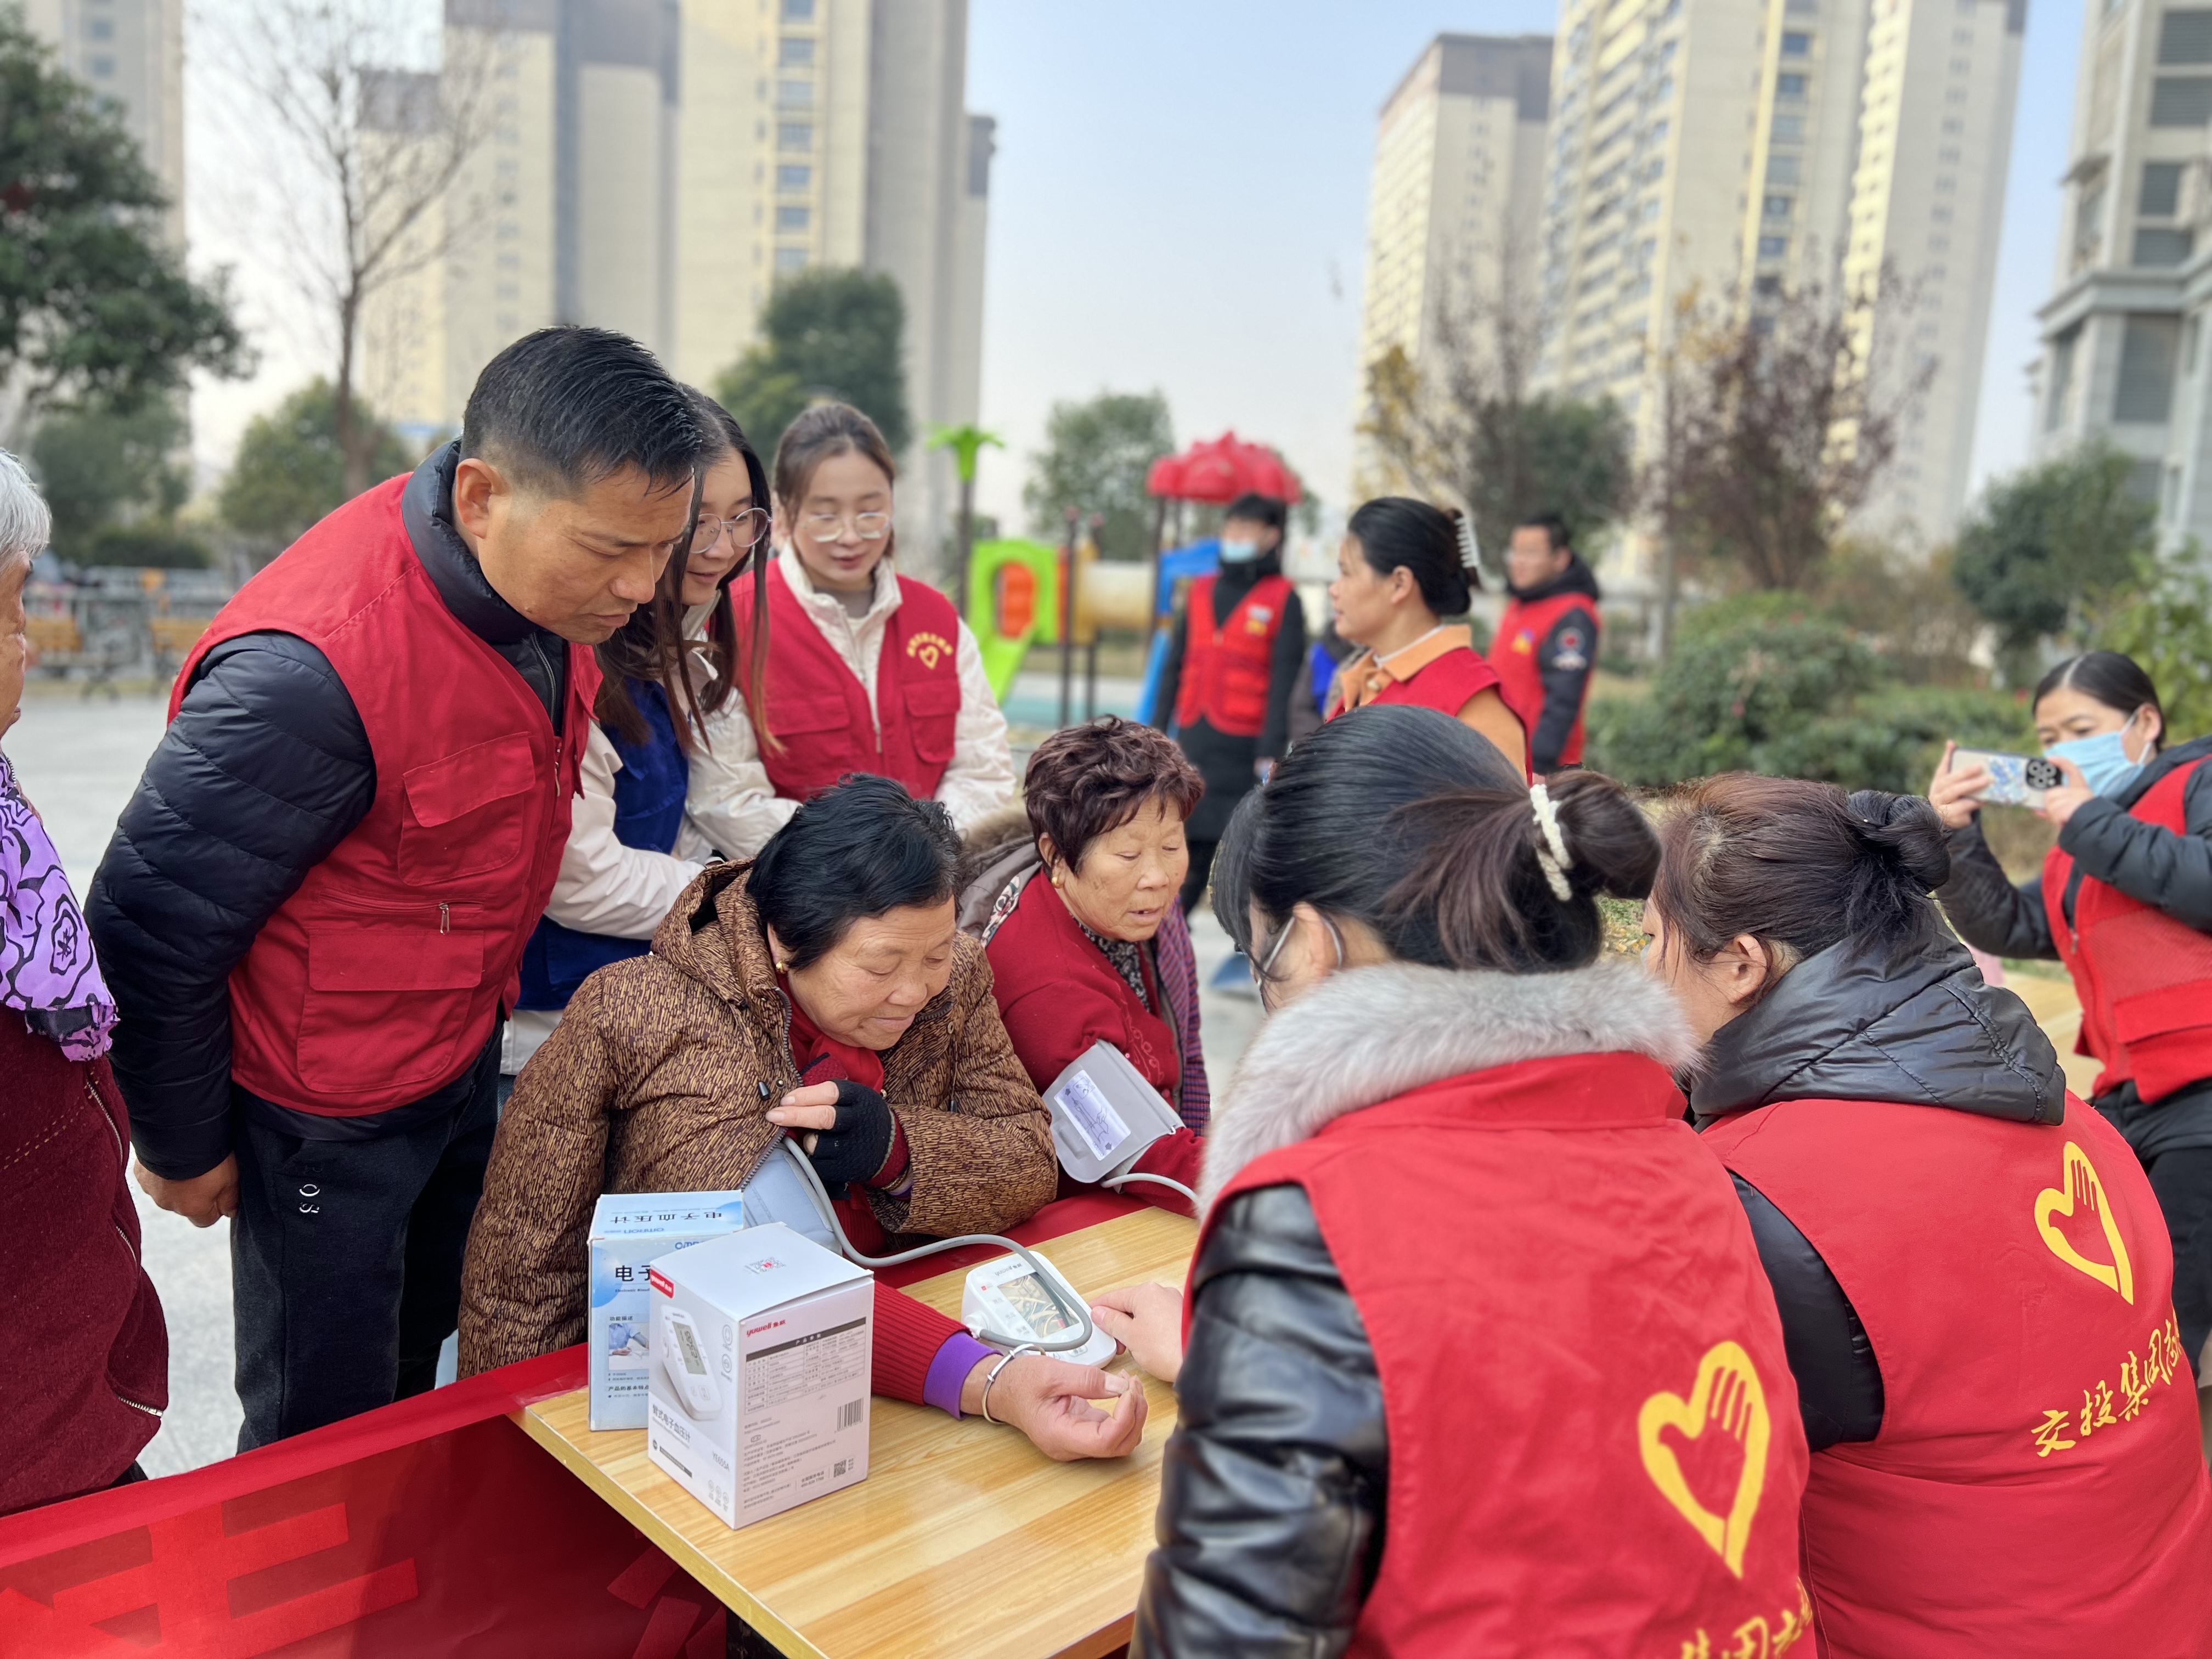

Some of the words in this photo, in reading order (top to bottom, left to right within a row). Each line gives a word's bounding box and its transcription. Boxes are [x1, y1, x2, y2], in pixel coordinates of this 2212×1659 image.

[610, 1211, 722, 1224] 电子血压计
